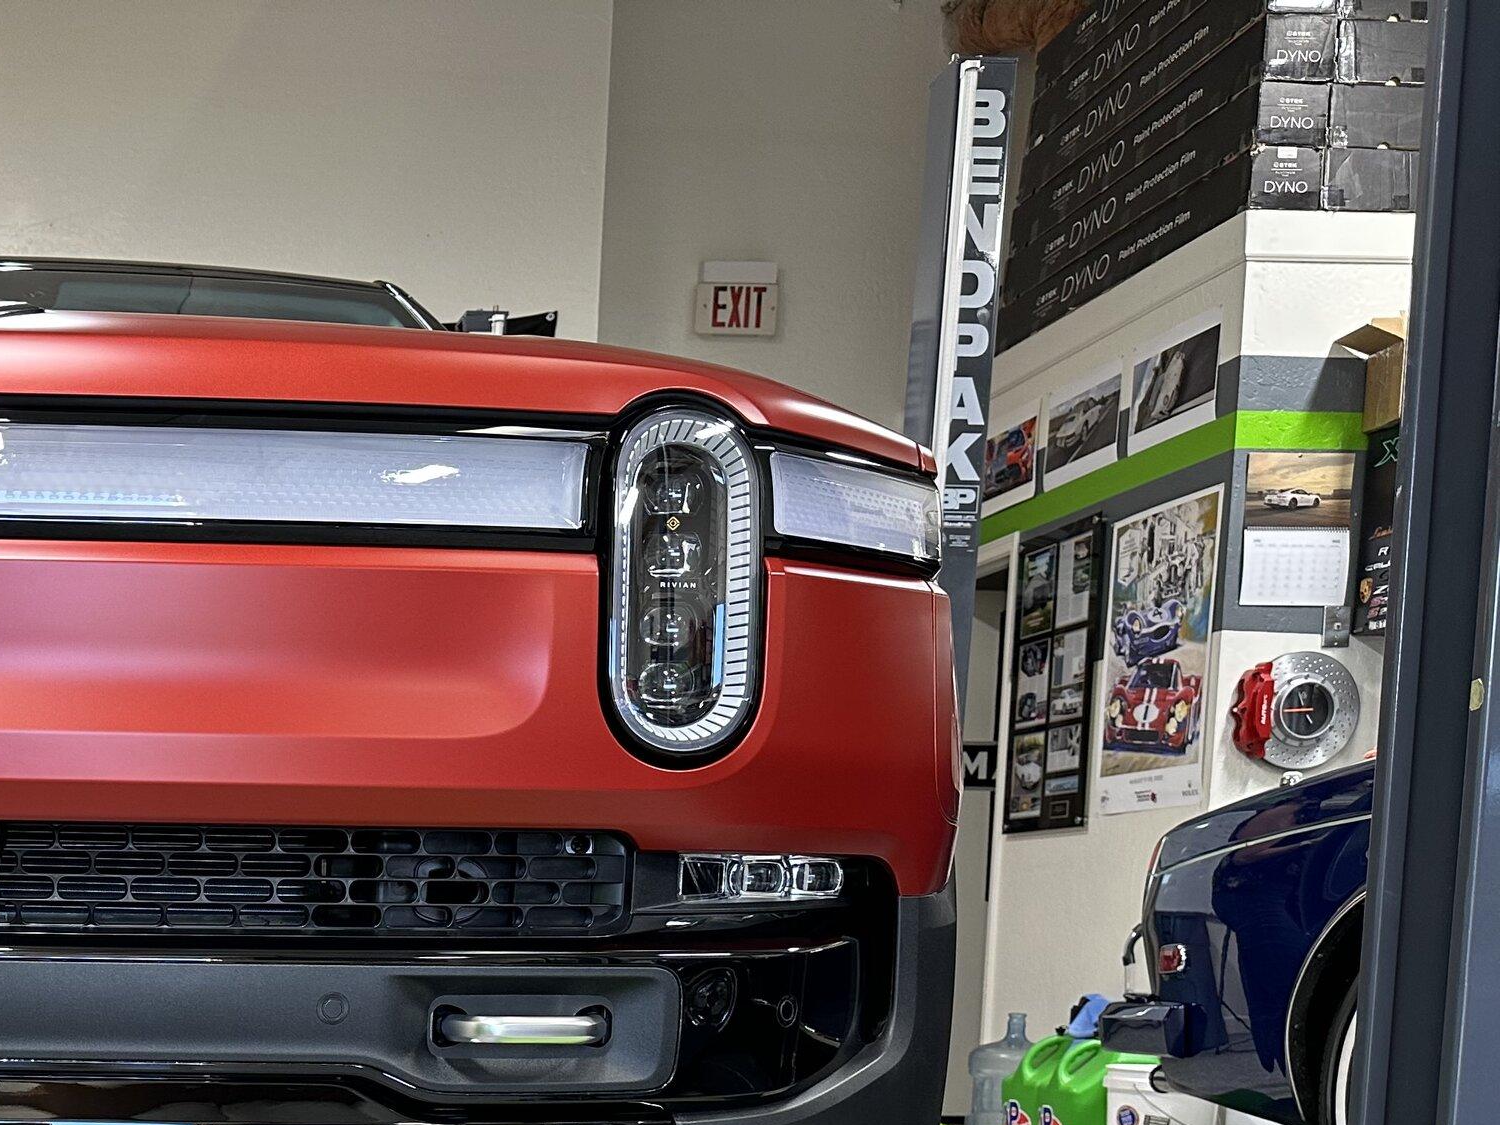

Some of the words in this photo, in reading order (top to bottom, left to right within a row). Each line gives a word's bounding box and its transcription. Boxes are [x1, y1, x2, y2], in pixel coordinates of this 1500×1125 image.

[1093, 23, 1140, 81] DYNO
[1276, 49, 1322, 63] DYNO
[1083, 82, 1132, 139] DYNO
[1140, 66, 1157, 87] Paint
[1157, 39, 1193, 73] Protection
[1077, 140, 1125, 194] DYNO
[1133, 126, 1151, 147] Paint
[1151, 100, 1187, 133] Protection
[1187, 88, 1204, 107] Film
[1270, 116, 1314, 129] DYNO
[1068, 197, 1117, 249] DYNO
[1125, 184, 1143, 204] Paint
[1143, 161, 1179, 191] Protection
[1180, 150, 1197, 167] Film
[1263, 181, 1309, 194] DYNO
[1061, 253, 1110, 303] DYNO
[1118, 243, 1136, 262] Paint
[1136, 221, 1173, 251] Protection
[1174, 211, 1191, 228] Film
[711, 285, 767, 329] EXIT
